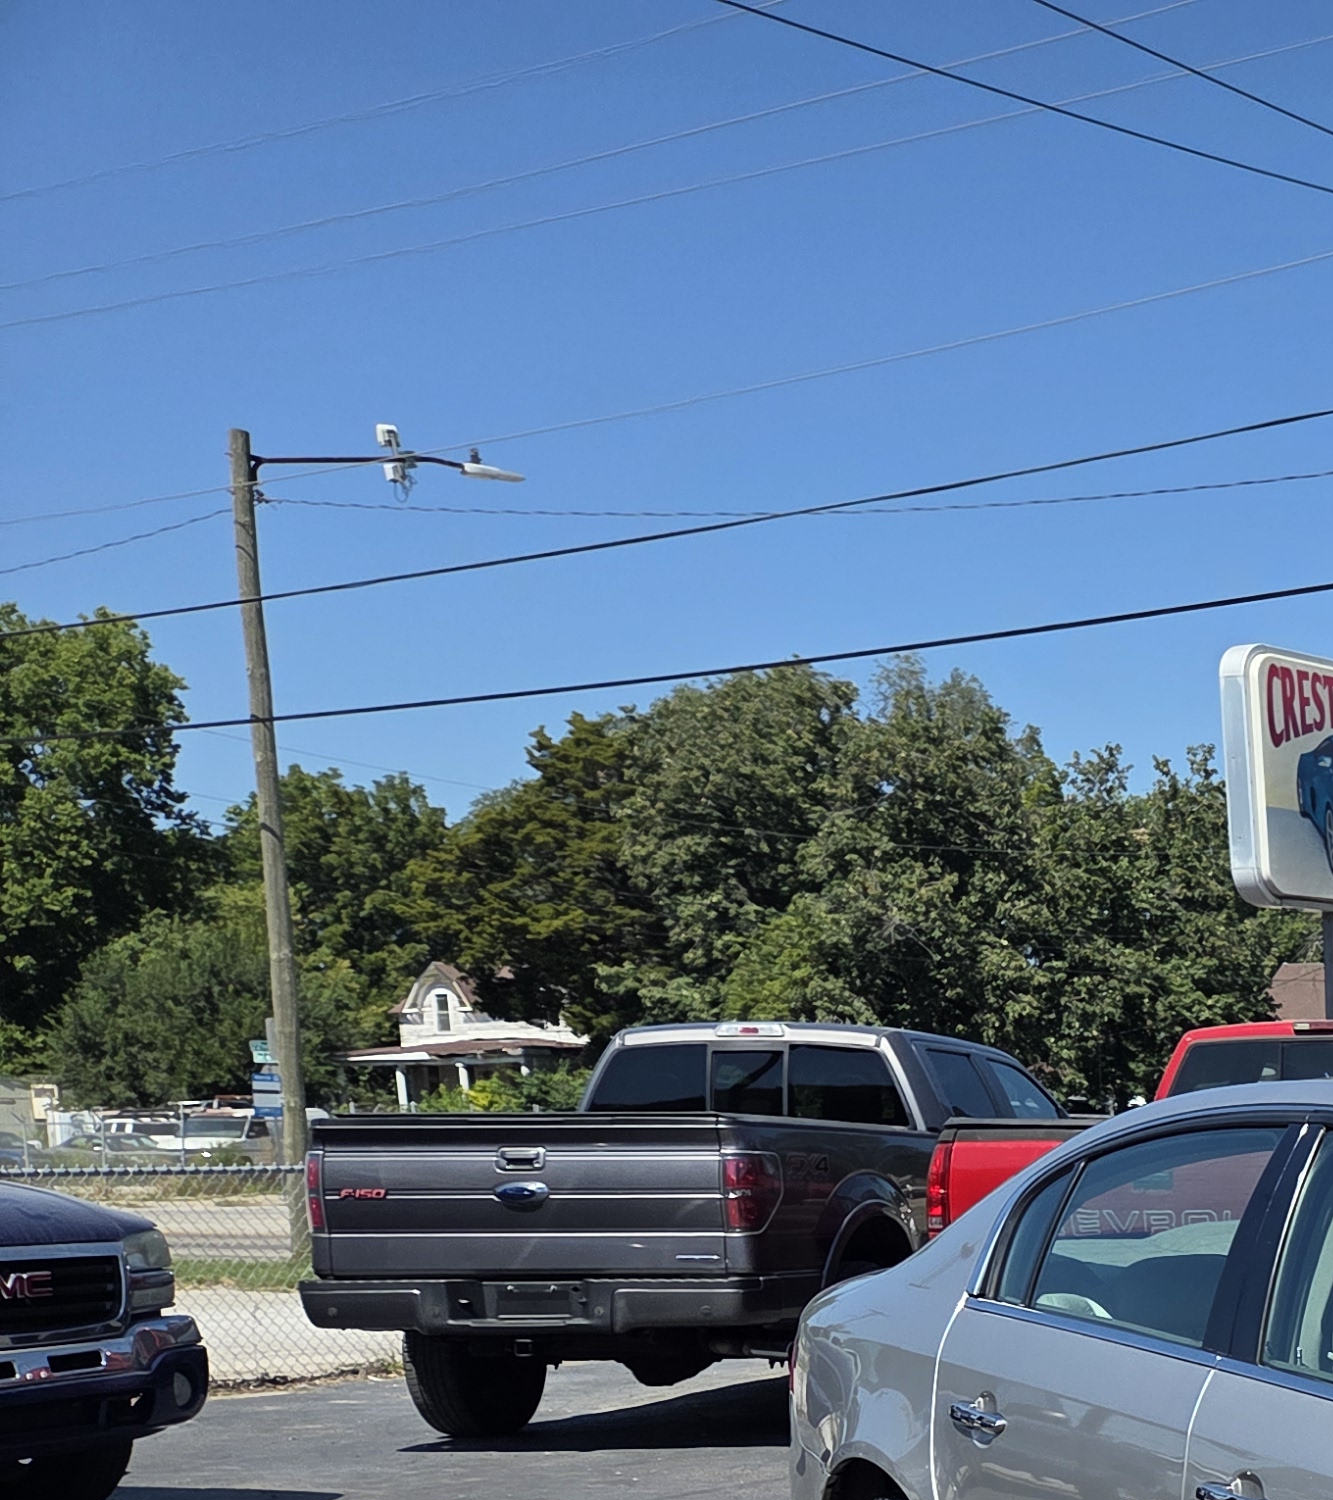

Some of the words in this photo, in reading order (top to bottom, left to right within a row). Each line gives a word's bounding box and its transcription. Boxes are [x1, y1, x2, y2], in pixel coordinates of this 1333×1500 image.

[339, 1188, 386, 1199] F-150
[1057, 1208, 1232, 1236] EVRO
[0, 1271, 53, 1299] MC
